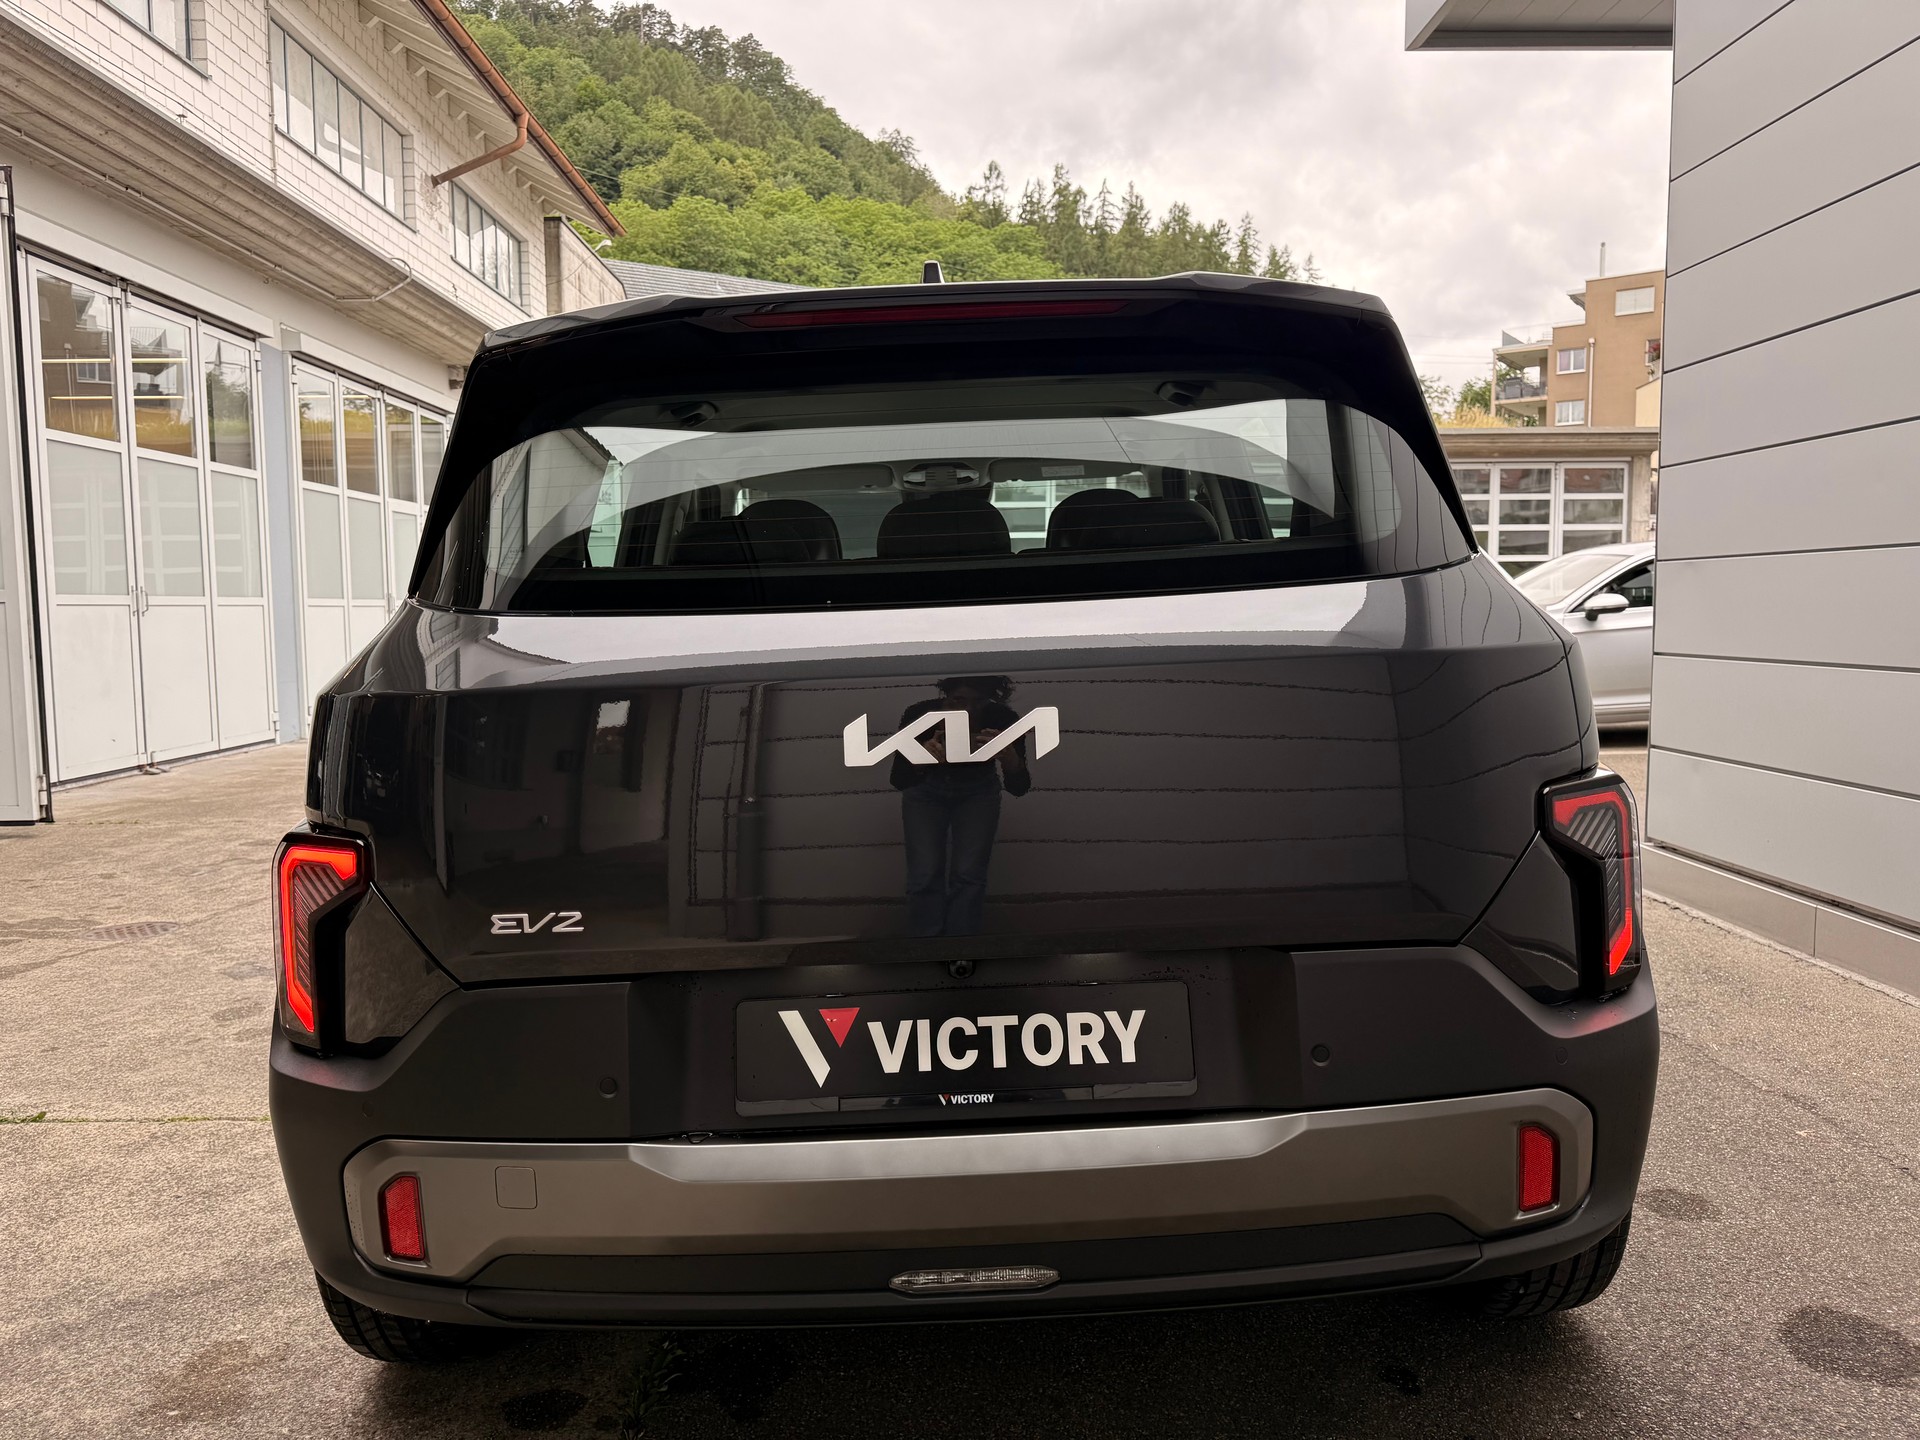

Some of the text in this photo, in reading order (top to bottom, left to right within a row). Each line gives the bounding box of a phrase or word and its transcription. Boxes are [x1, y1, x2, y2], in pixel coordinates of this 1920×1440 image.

[843, 706, 1060, 767] KIA
[490, 911, 585, 934] EV2
[866, 1009, 1147, 1074] VICTORY
[950, 1093, 995, 1105] VICTORY
